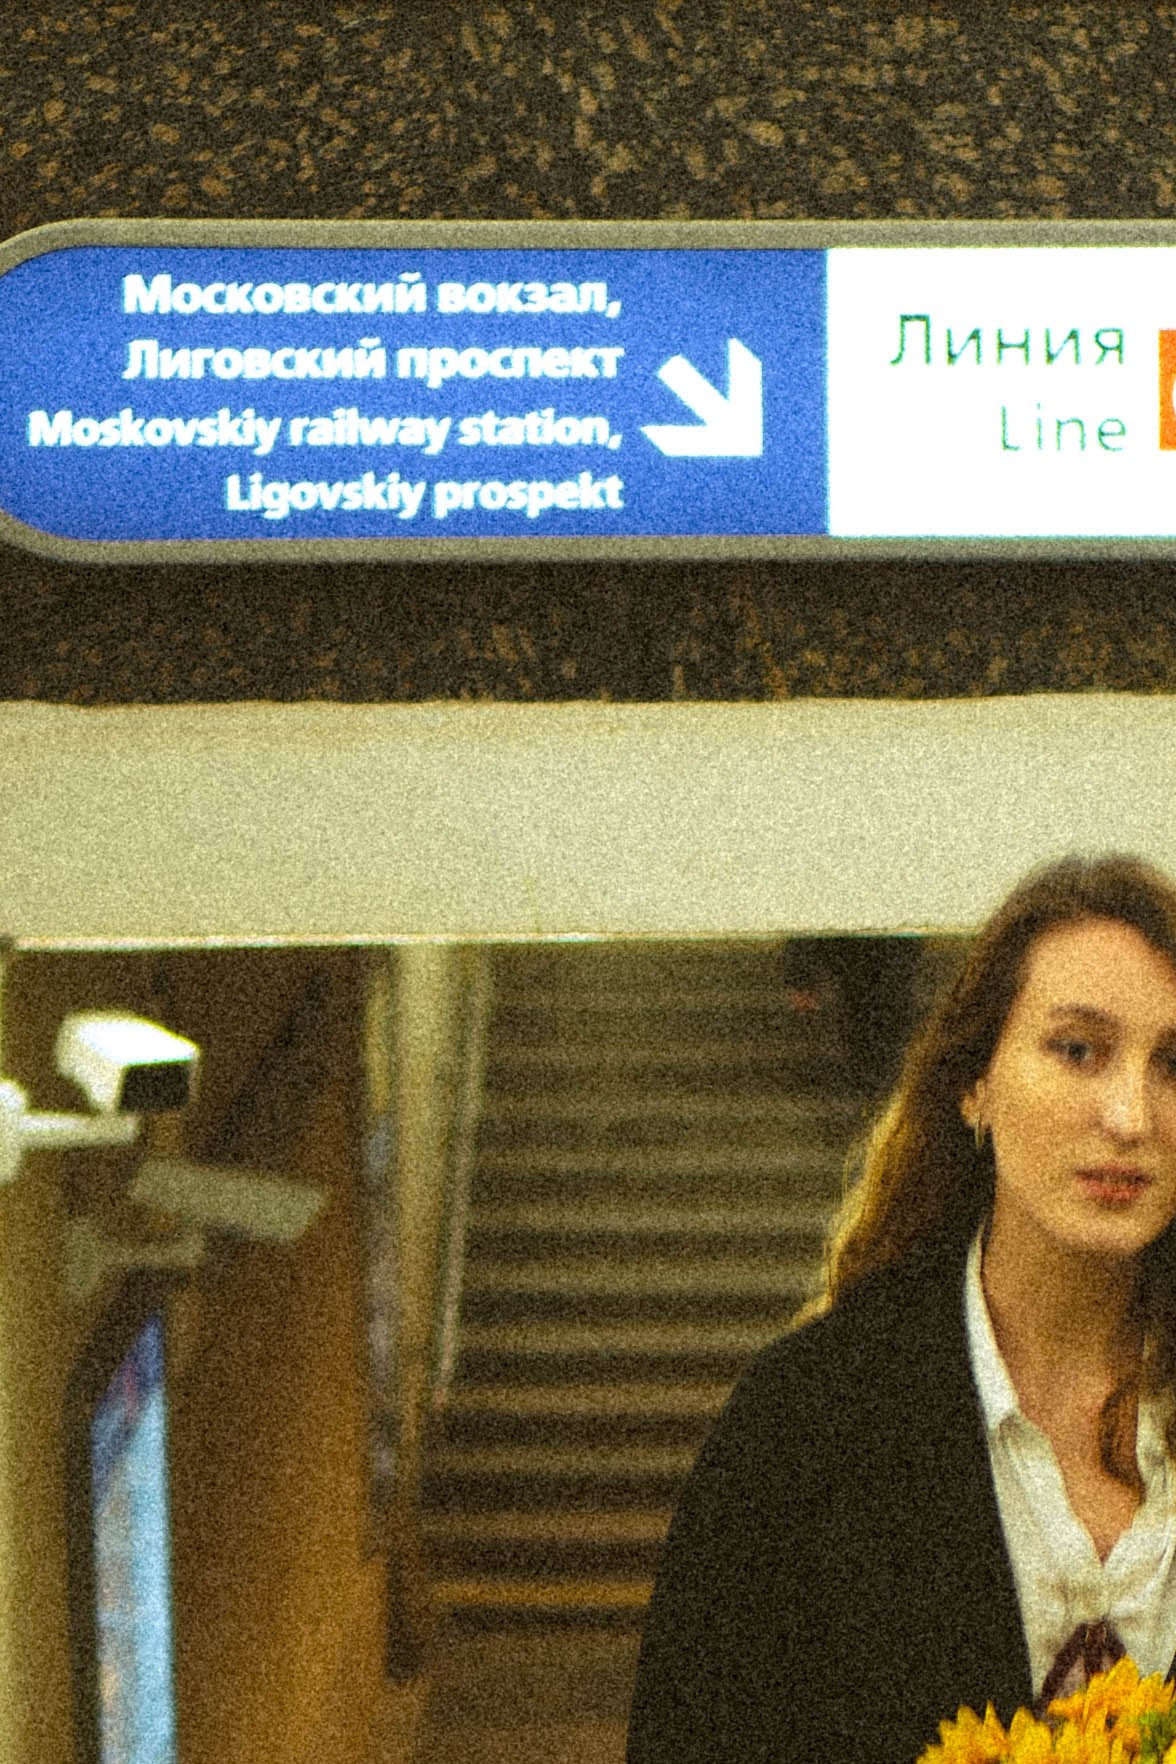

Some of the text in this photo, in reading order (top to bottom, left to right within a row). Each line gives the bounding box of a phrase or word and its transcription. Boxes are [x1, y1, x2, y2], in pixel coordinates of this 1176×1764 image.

[124, 273, 622, 318] Московский вокзал,
[123, 338, 625, 388] Лиговский проспект
[890, 314, 1124, 365] Линия
[29, 408, 622, 456] Moskovskiy railway station,
[1002, 403, 1127, 452] Line
[228, 472, 624, 520] Ligovskiy prospekt
